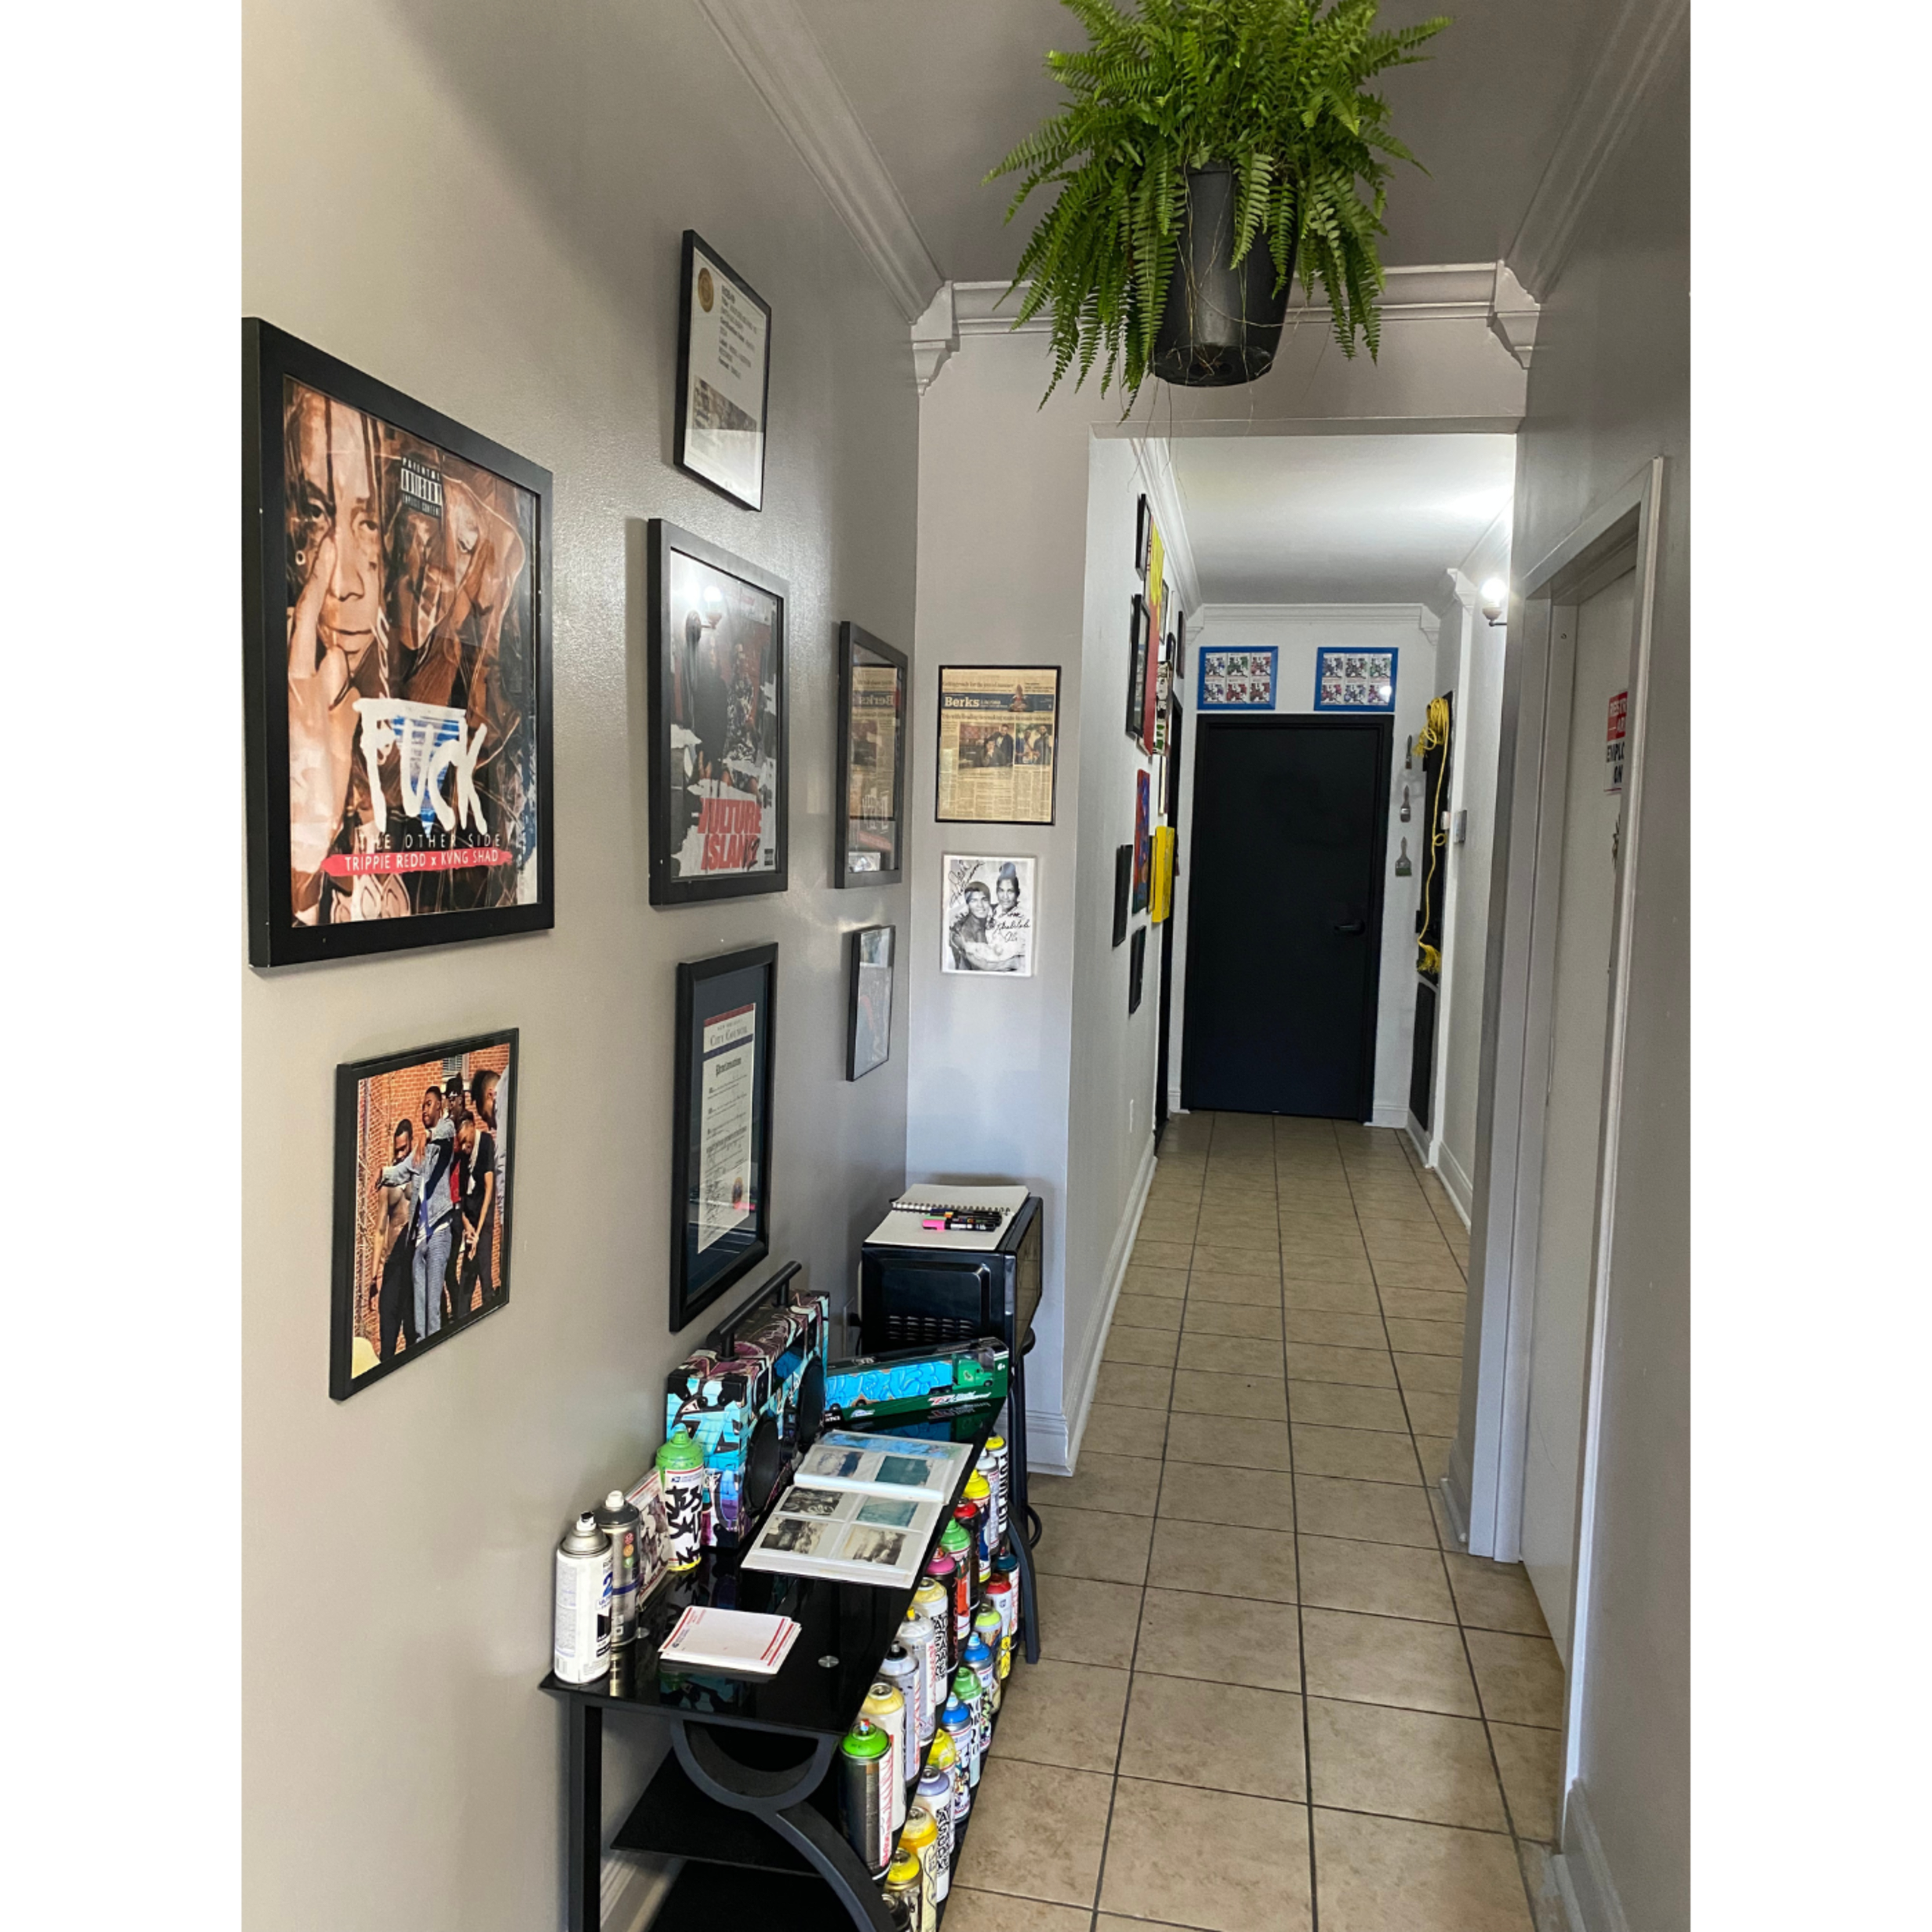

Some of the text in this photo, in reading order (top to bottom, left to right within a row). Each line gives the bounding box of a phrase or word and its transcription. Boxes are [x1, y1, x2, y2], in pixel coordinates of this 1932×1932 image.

[944, 696, 980, 707] Berks
[359, 832, 502, 850] THE OTHER SIDE
[345, 855, 391, 871] TRIPPIE
[396, 854, 427, 869] REDD
[441, 851, 469, 865] KVNG
[472, 849, 499, 864] SHAD
